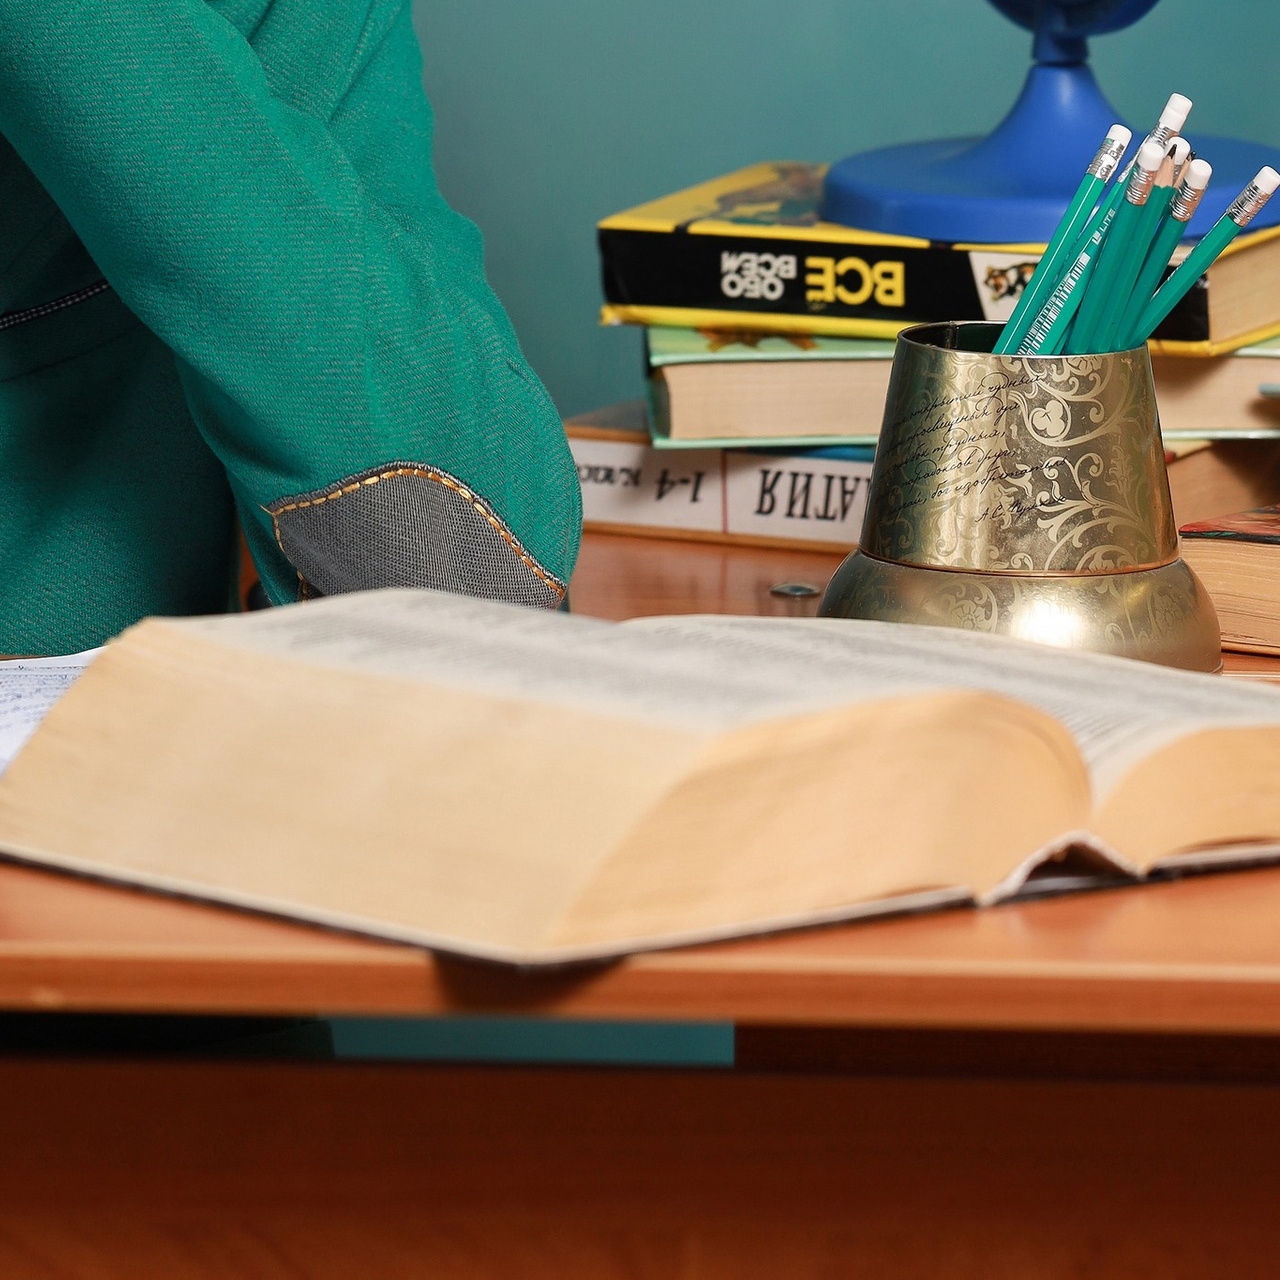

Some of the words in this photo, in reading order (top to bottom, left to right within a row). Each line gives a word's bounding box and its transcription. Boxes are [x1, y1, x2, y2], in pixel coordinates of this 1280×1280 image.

[1099, 208, 1116, 232] LITE
[721, 251, 798, 280] ВСЕМ
[721, 272, 785, 301] ОБО
[655, 467, 705, 503] 1-4
[754, 469, 870, 522] АТИЯ
